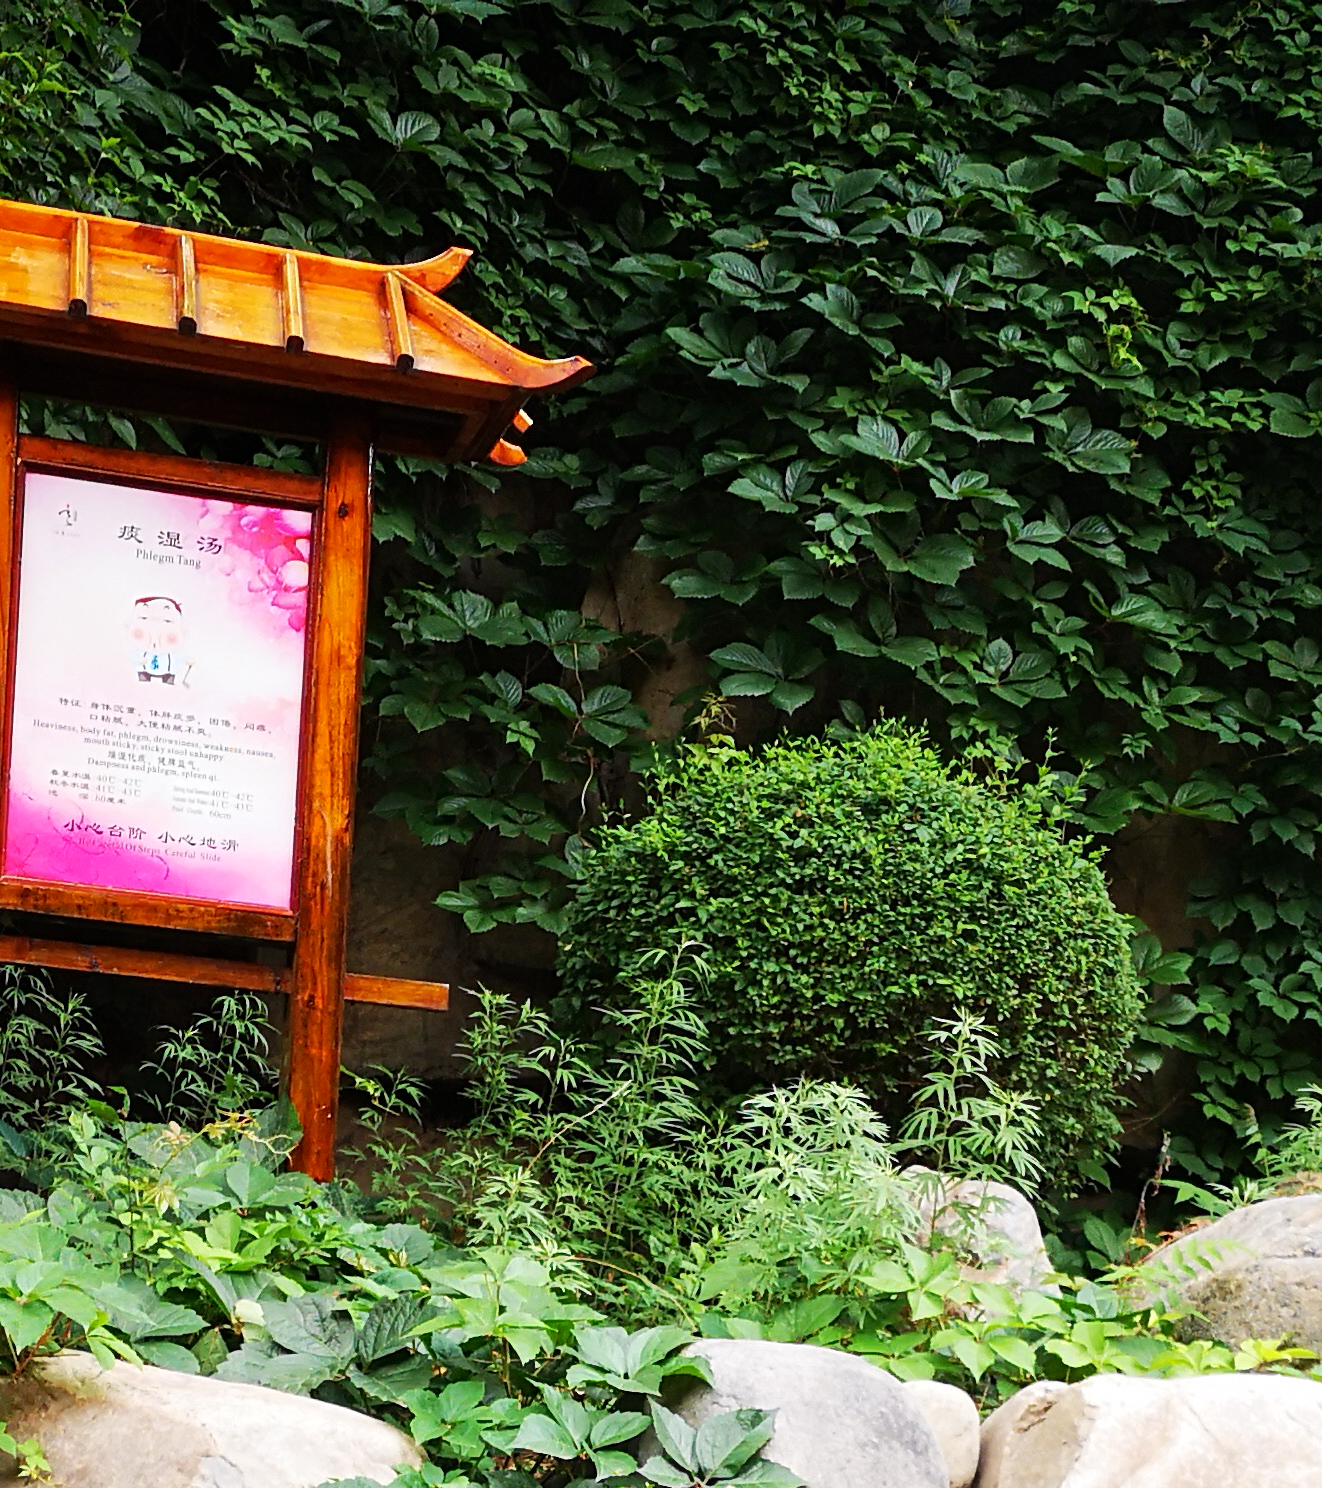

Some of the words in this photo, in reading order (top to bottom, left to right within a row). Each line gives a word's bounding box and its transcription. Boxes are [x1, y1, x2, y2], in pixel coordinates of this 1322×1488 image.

[118, 525, 223, 555] 痰湿汤
[136, 548, 175, 566] Phlegm
[177, 554, 202, 570] Tang
[63, 819, 147, 840] 小心台阶
[157, 831, 239, 852] 小心地滑
